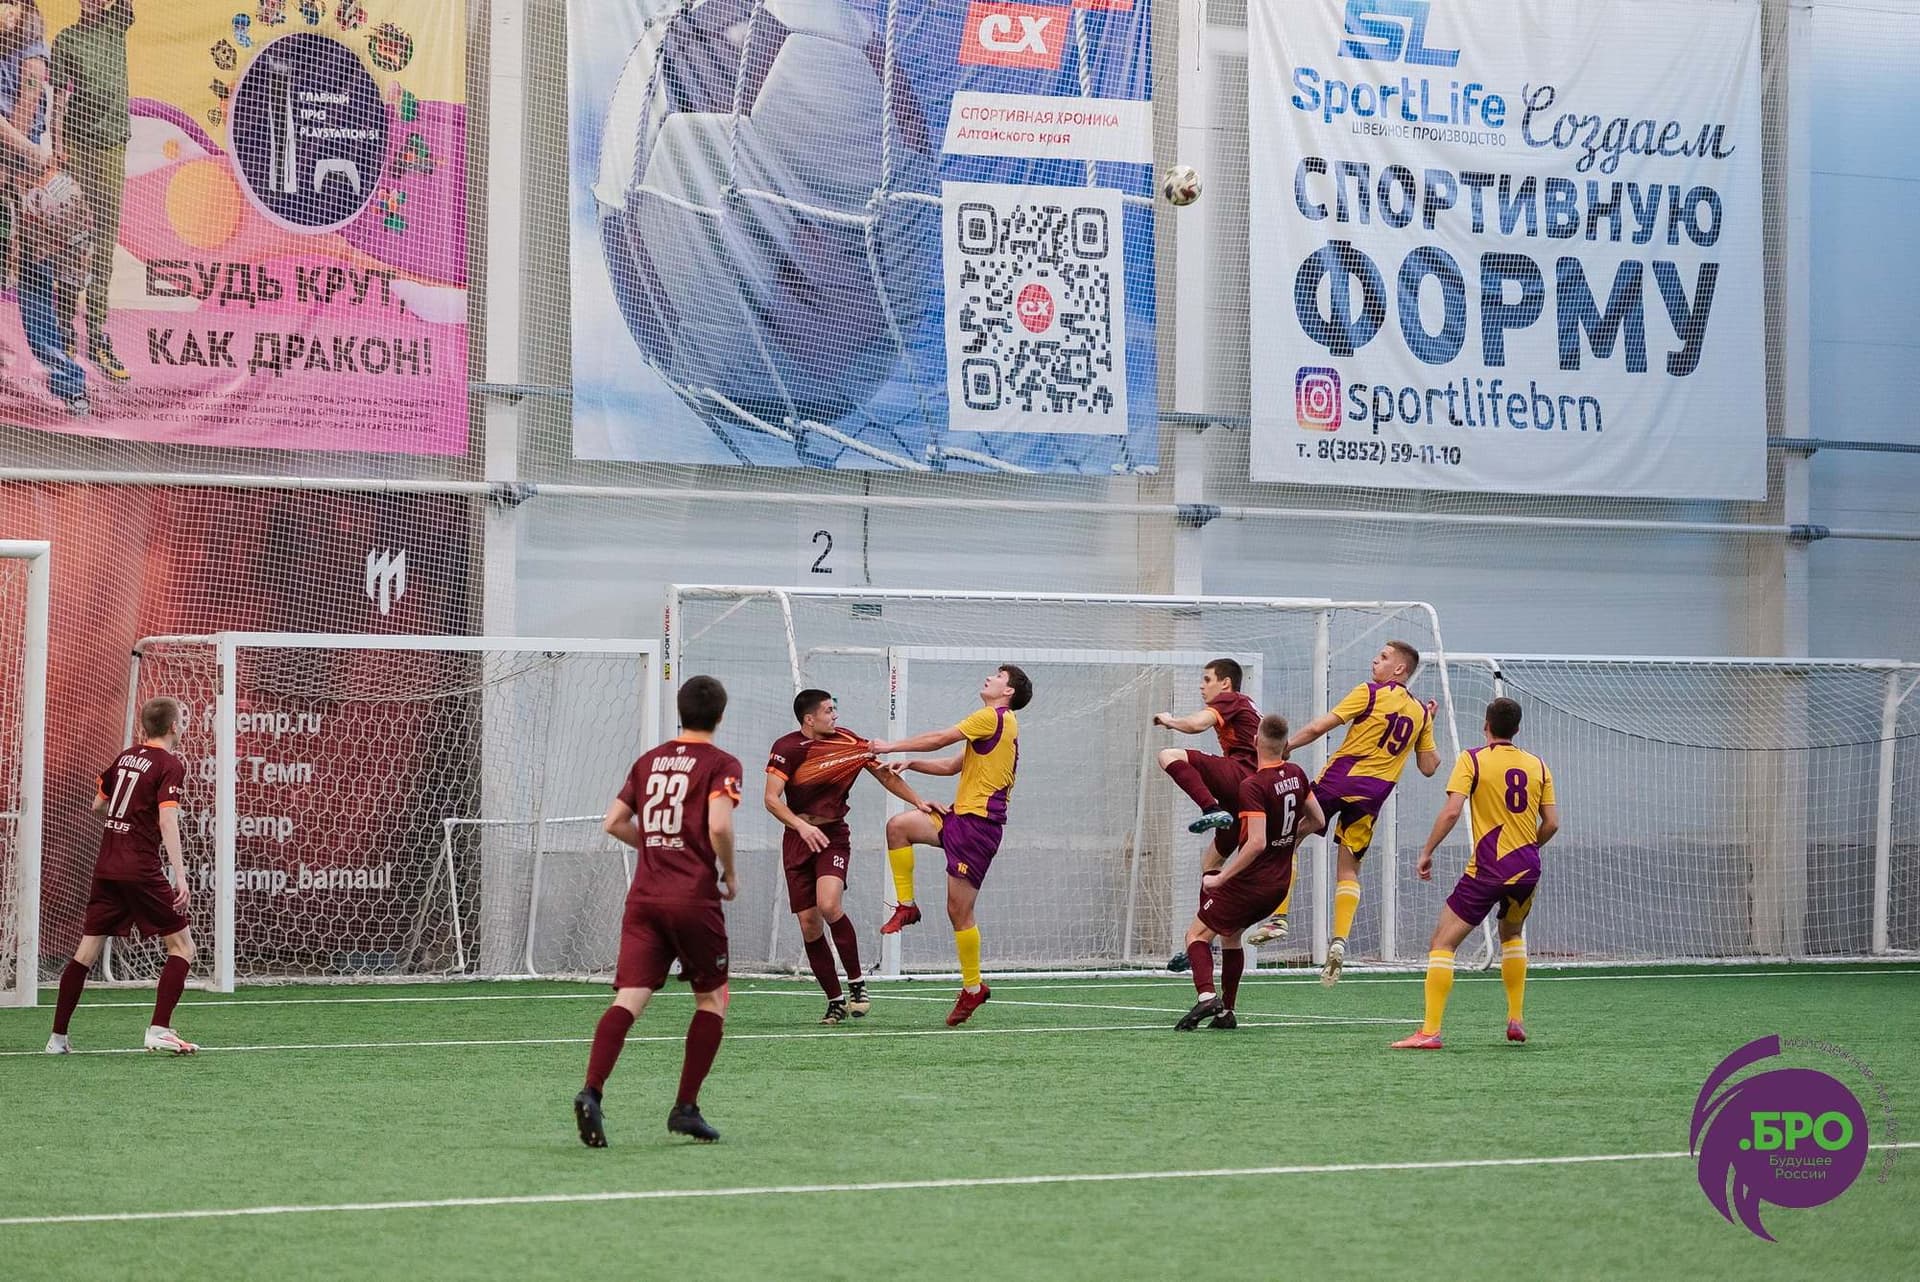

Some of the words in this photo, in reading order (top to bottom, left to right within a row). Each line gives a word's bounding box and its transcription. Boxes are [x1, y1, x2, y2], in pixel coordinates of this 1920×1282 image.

[300, 91, 349, 104] ГЛАВНЫЙ
[300, 109, 326, 120] ПРИЗ
[961, 106, 1054, 124] СПОРТИВНАЯ
[1056, 111, 1120, 127] ХРОНИКА
[1291, 66, 1506, 129] SportLife
[300, 127, 366, 139] PLAYSTATION
[957, 127, 1035, 143] Алтайского
[1039, 132, 1071, 146] края
[1412, 126, 1506, 146] ПРОИЗВОДСТВО
[1521, 82, 1736, 173] Создаем
[1294, 157, 1723, 247] СПОРТИВНУЮ
[145, 258, 283, 308] БУДЬ
[295, 264, 406, 314] КРУТ,
[1294, 239, 1720, 377] ФОРМУ
[147, 327, 237, 368] КАК
[247, 331, 432, 378] ДРАКОН!
[1349, 377, 1603, 434] sportlifebrn
[1318, 438, 1387, 464] 8(3852)
[1390, 443, 1462, 465] 59-11-10
[811, 530, 833, 573] 2
[1377, 711, 1414, 756] 19
[248, 757, 314, 783] Темп
[1273, 776, 1300, 795] КНЯЗЕВ
[1504, 768, 1528, 813] 8
[107, 768, 140, 819] 17
[643, 773, 689, 834] 23
[1280, 793, 1297, 837] 6
[833, 855, 845, 869] 22
